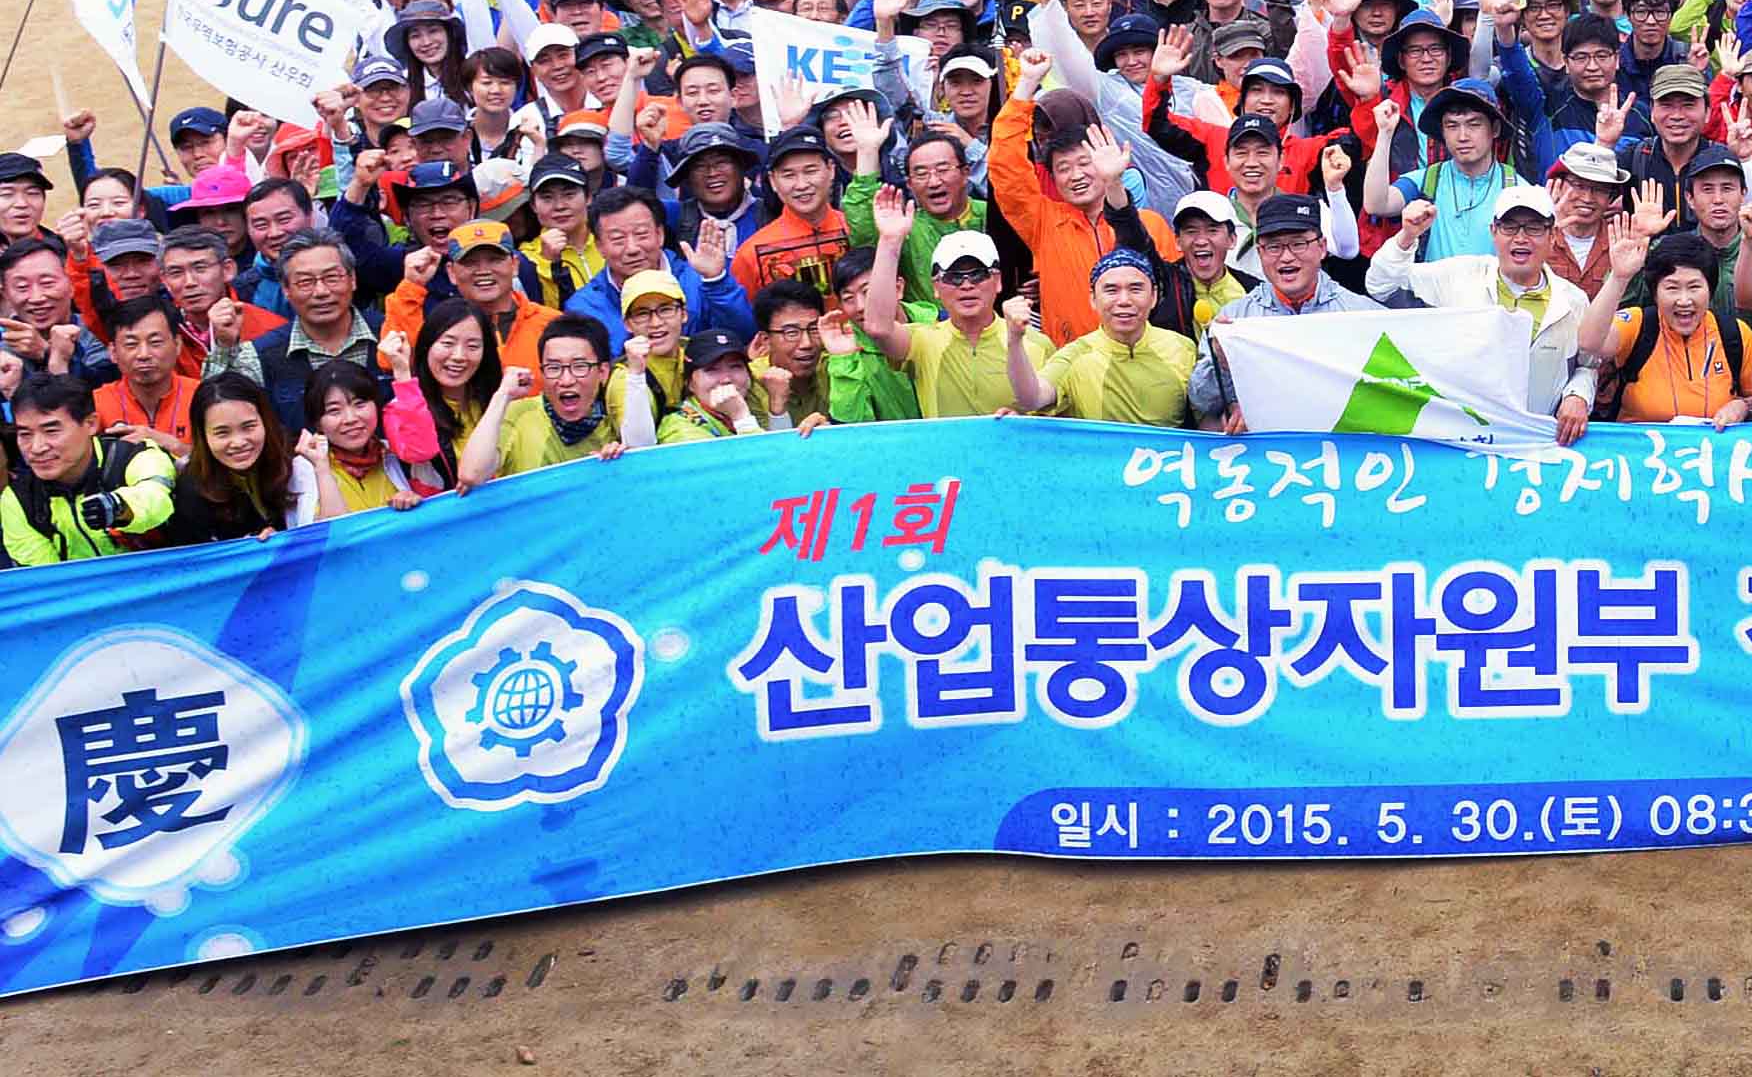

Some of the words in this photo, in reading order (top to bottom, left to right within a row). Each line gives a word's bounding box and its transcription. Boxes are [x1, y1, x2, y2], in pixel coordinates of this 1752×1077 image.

[1011, 5, 1024, 20] P
[759, 479, 962, 563] 제1회
[1123, 440, 1427, 529] 역동적인
[737, 565, 1692, 734] 산업통상자원부
[54, 687, 234, 856] 慶
[1049, 800, 1141, 849] 일시
[1206, 802, 1349, 847] 2015.
[1377, 802, 1424, 845] 5.
[1450, 793, 1623, 843] 30.(토)
